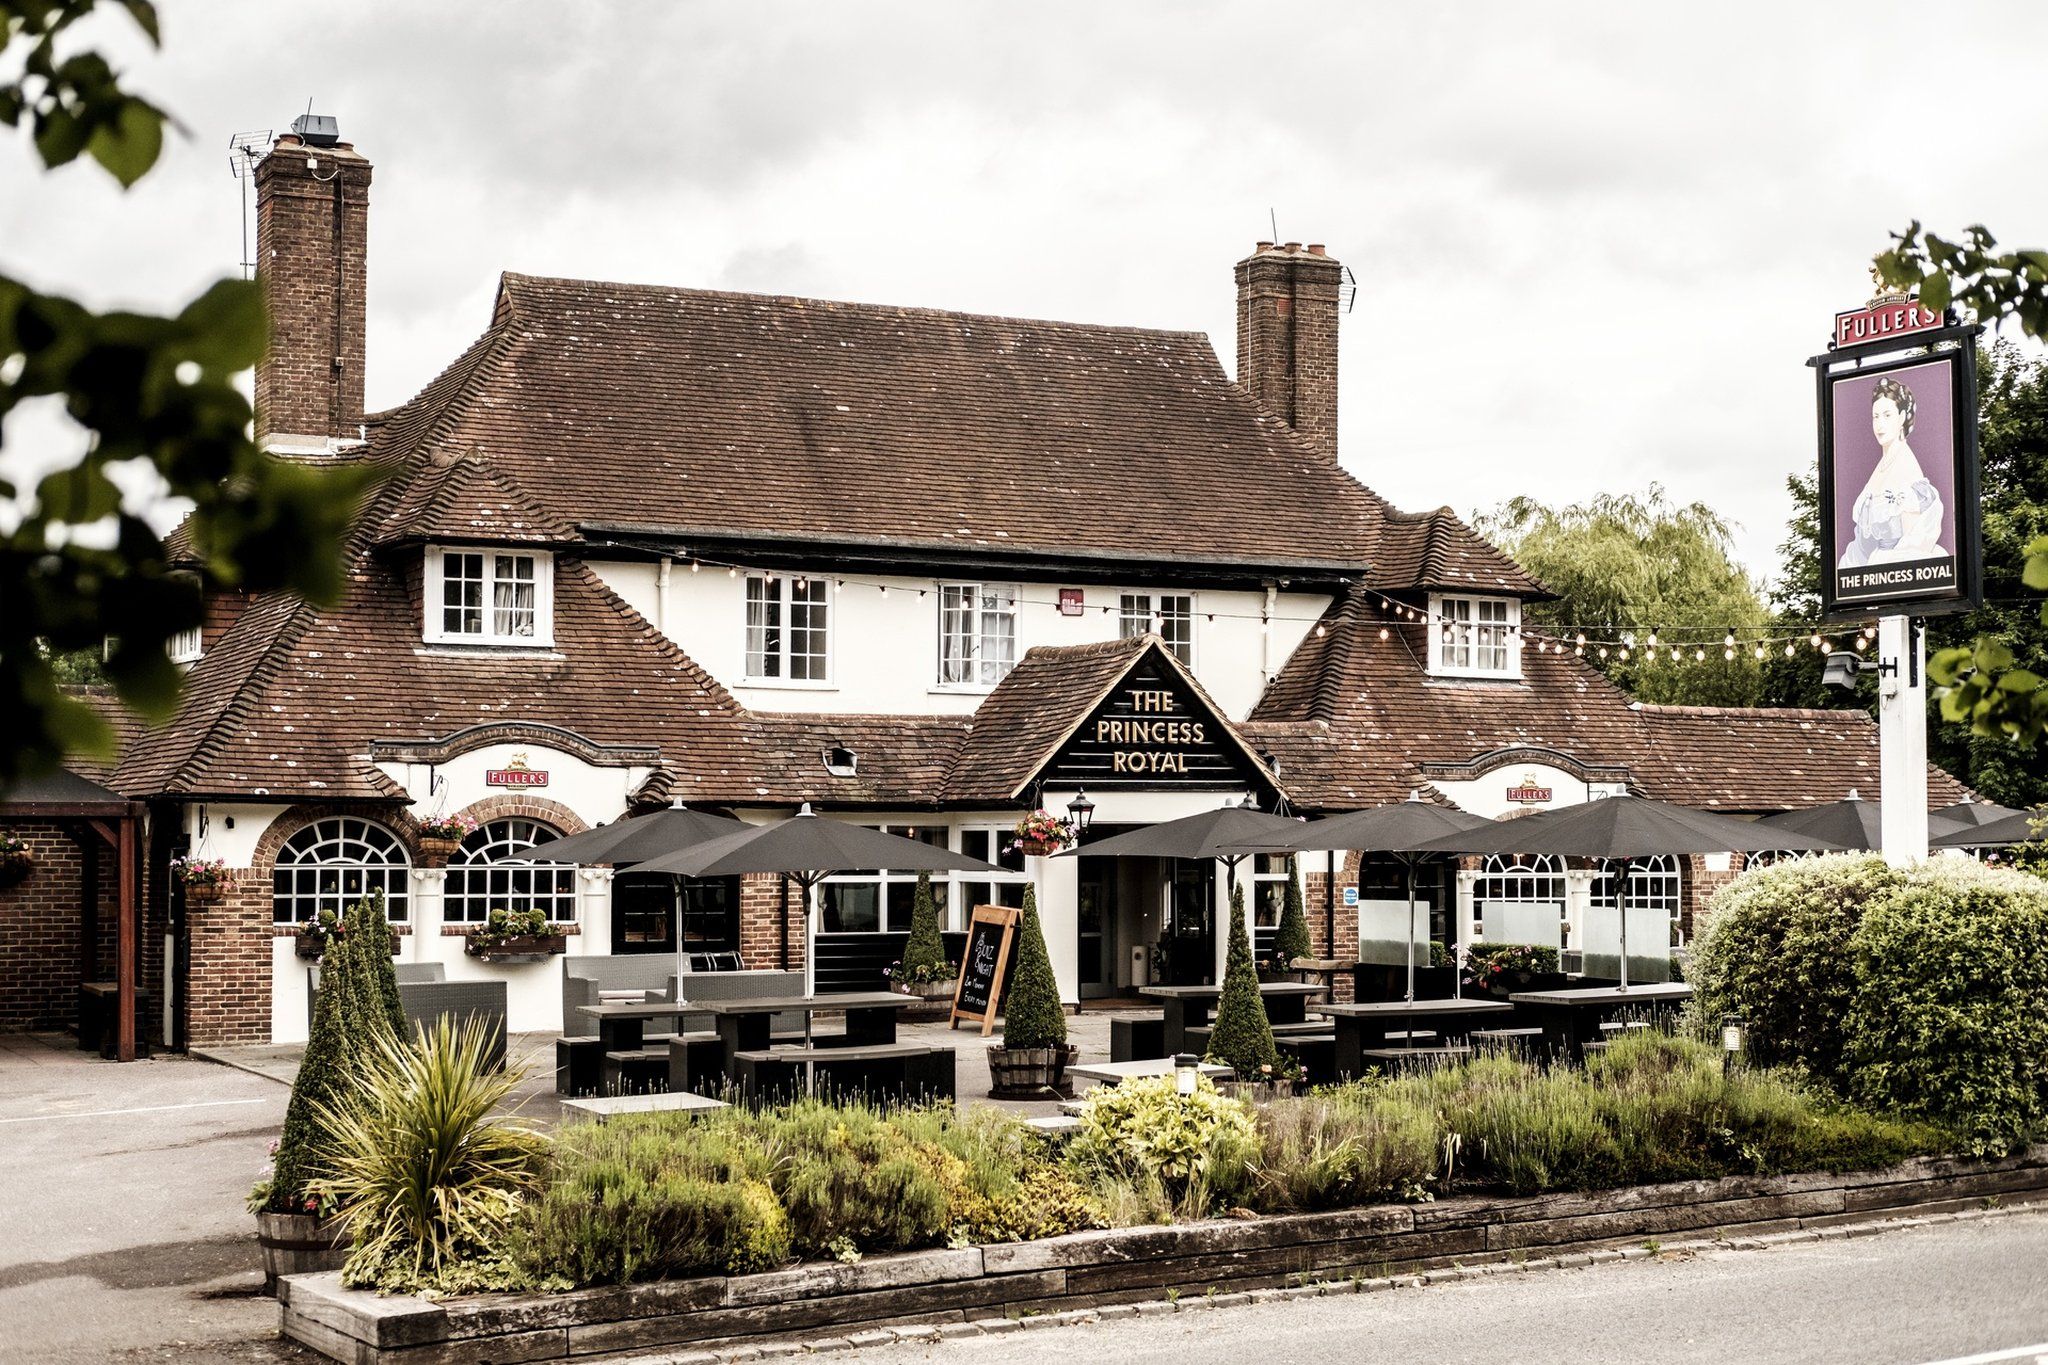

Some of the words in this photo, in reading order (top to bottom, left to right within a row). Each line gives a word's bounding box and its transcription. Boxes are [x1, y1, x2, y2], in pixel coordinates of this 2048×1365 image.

[1840, 576, 1860, 588] THE
[1863, 569, 1913, 586] PRINCESS
[1916, 565, 1952, 580] ROYAL
[1132, 691, 1173, 712] THE
[1097, 721, 1204, 743] PRINCESS
[1114, 752, 1189, 772] ROYAL
